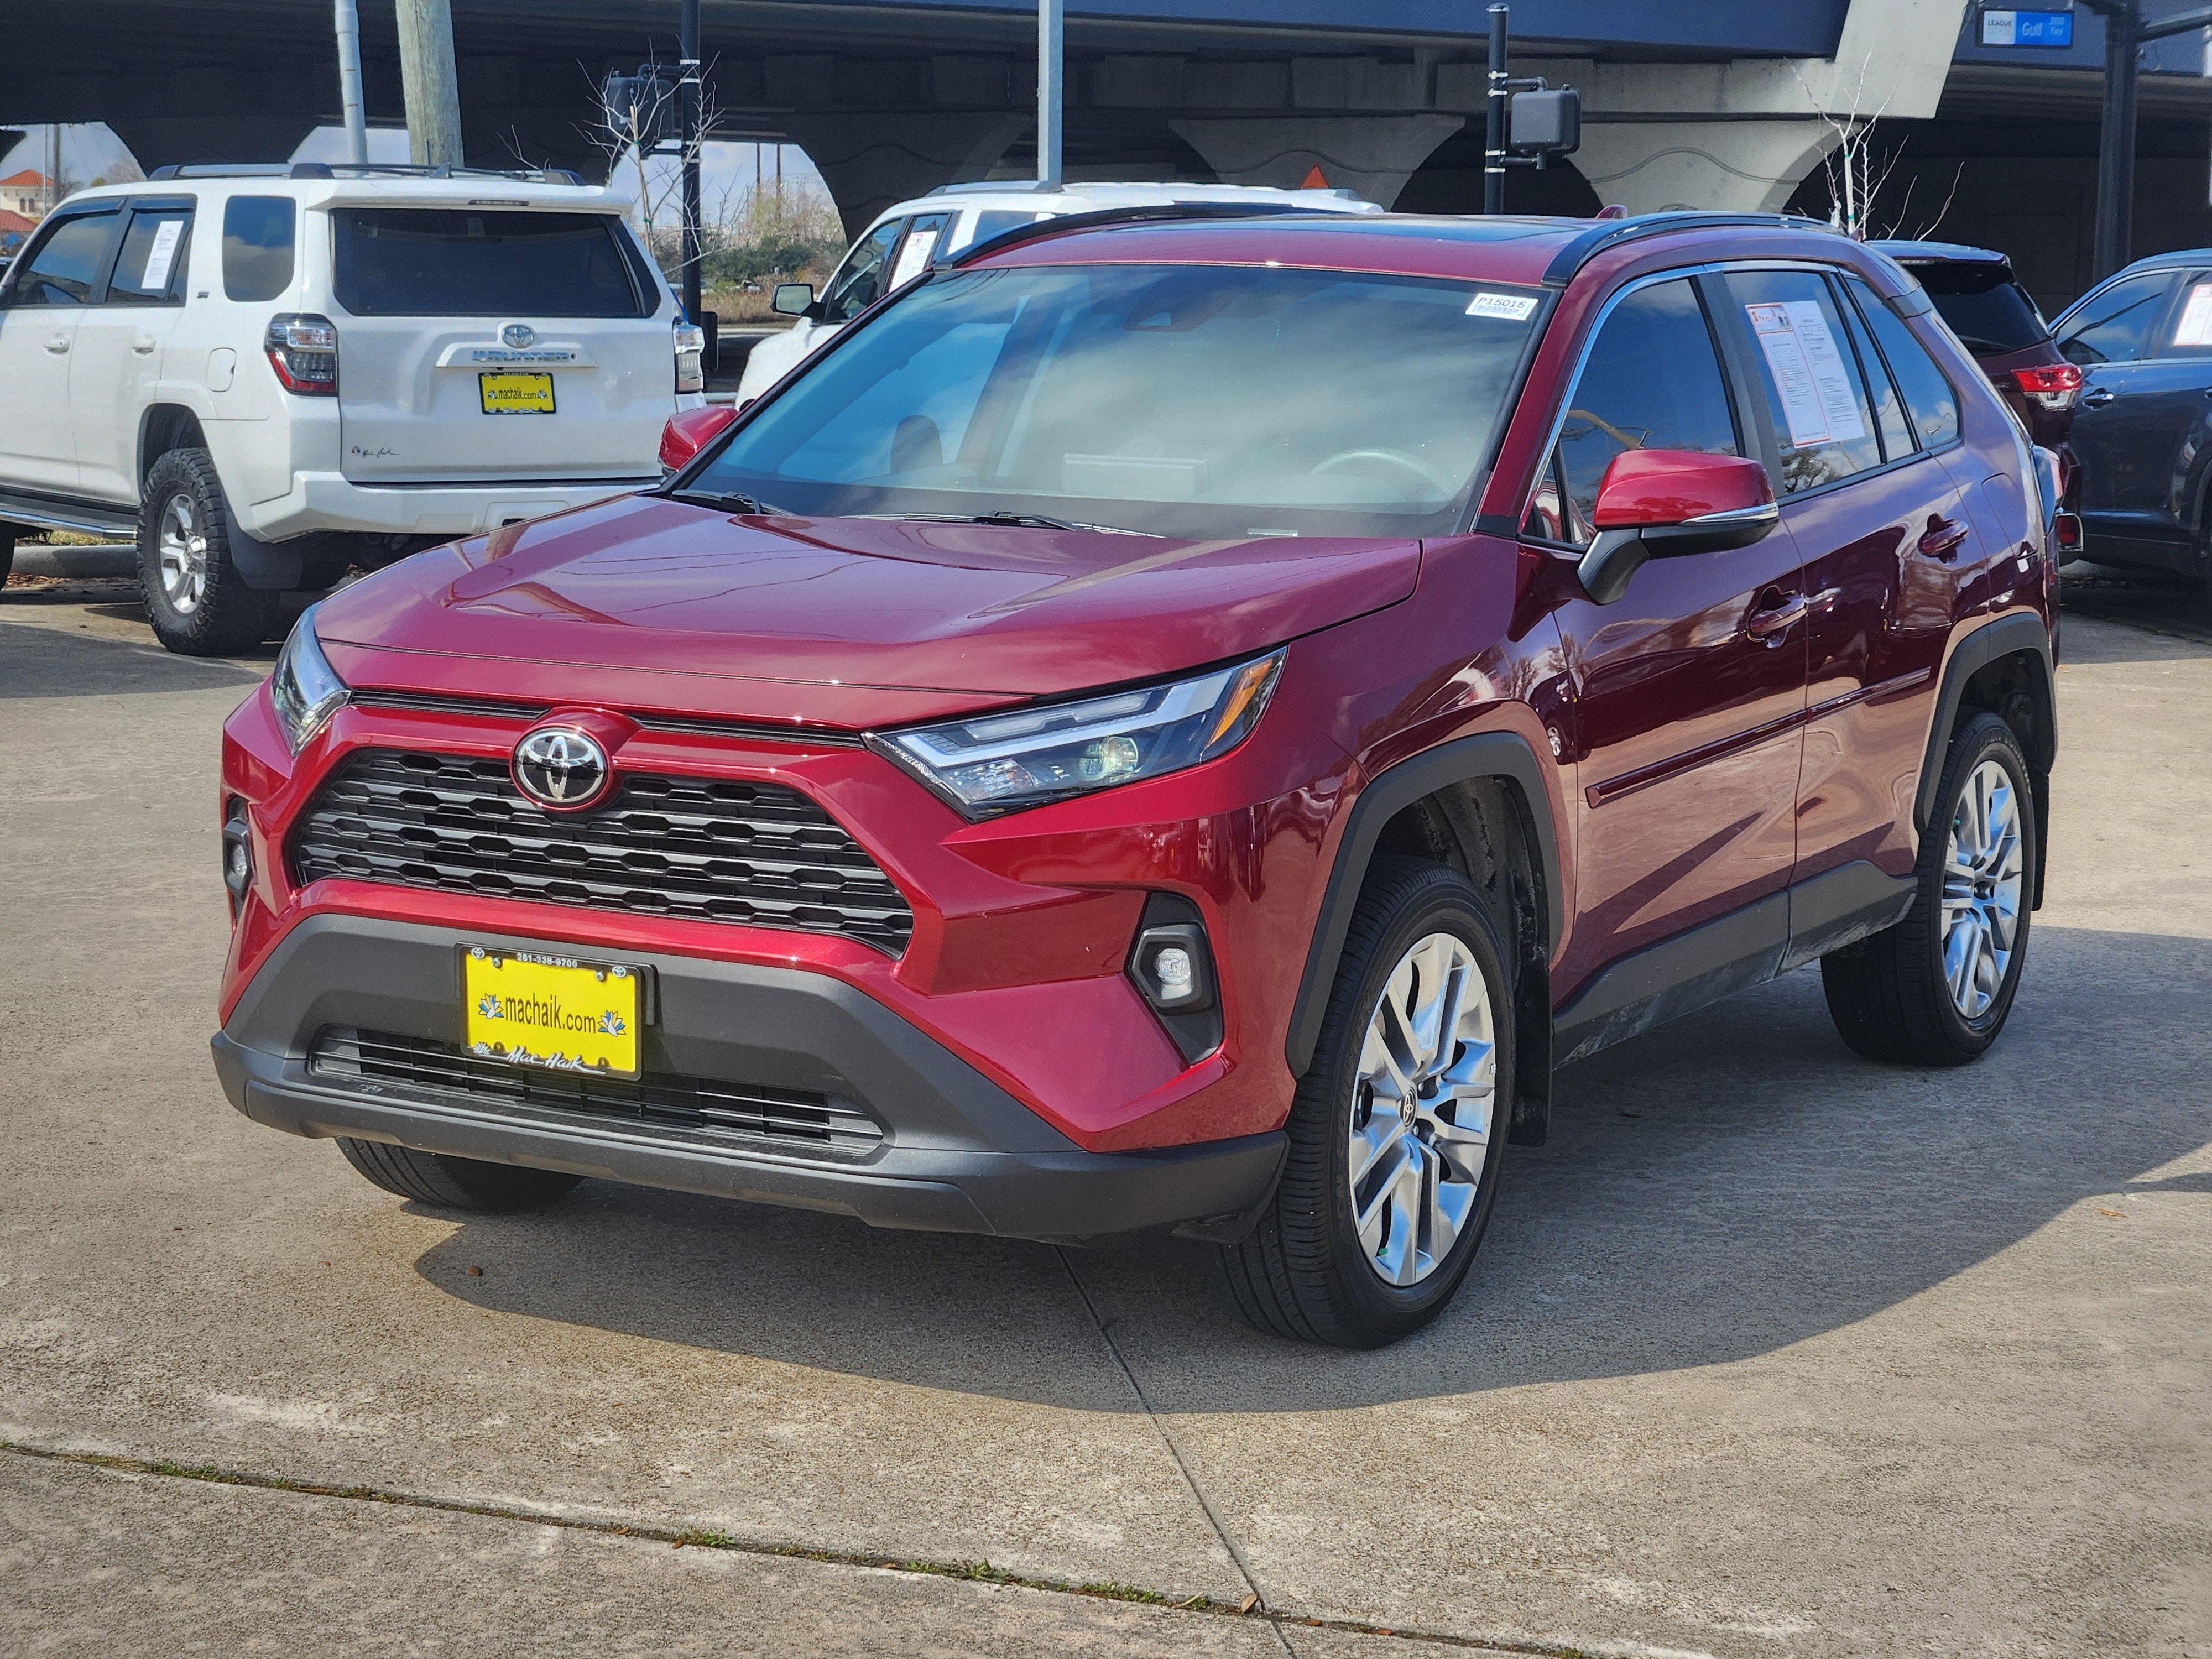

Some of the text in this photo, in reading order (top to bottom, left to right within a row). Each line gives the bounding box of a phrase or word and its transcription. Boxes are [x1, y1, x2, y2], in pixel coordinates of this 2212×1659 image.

[2022, 21, 2043, 36] Gulf
[1477, 296, 1527, 309] P15015
[498, 387, 536, 400] machaik.com
[516, 952, 578, 969] 281-338-9700
[504, 992, 596, 1034] machaik.com
[506, 1045, 545, 1063] Mac
